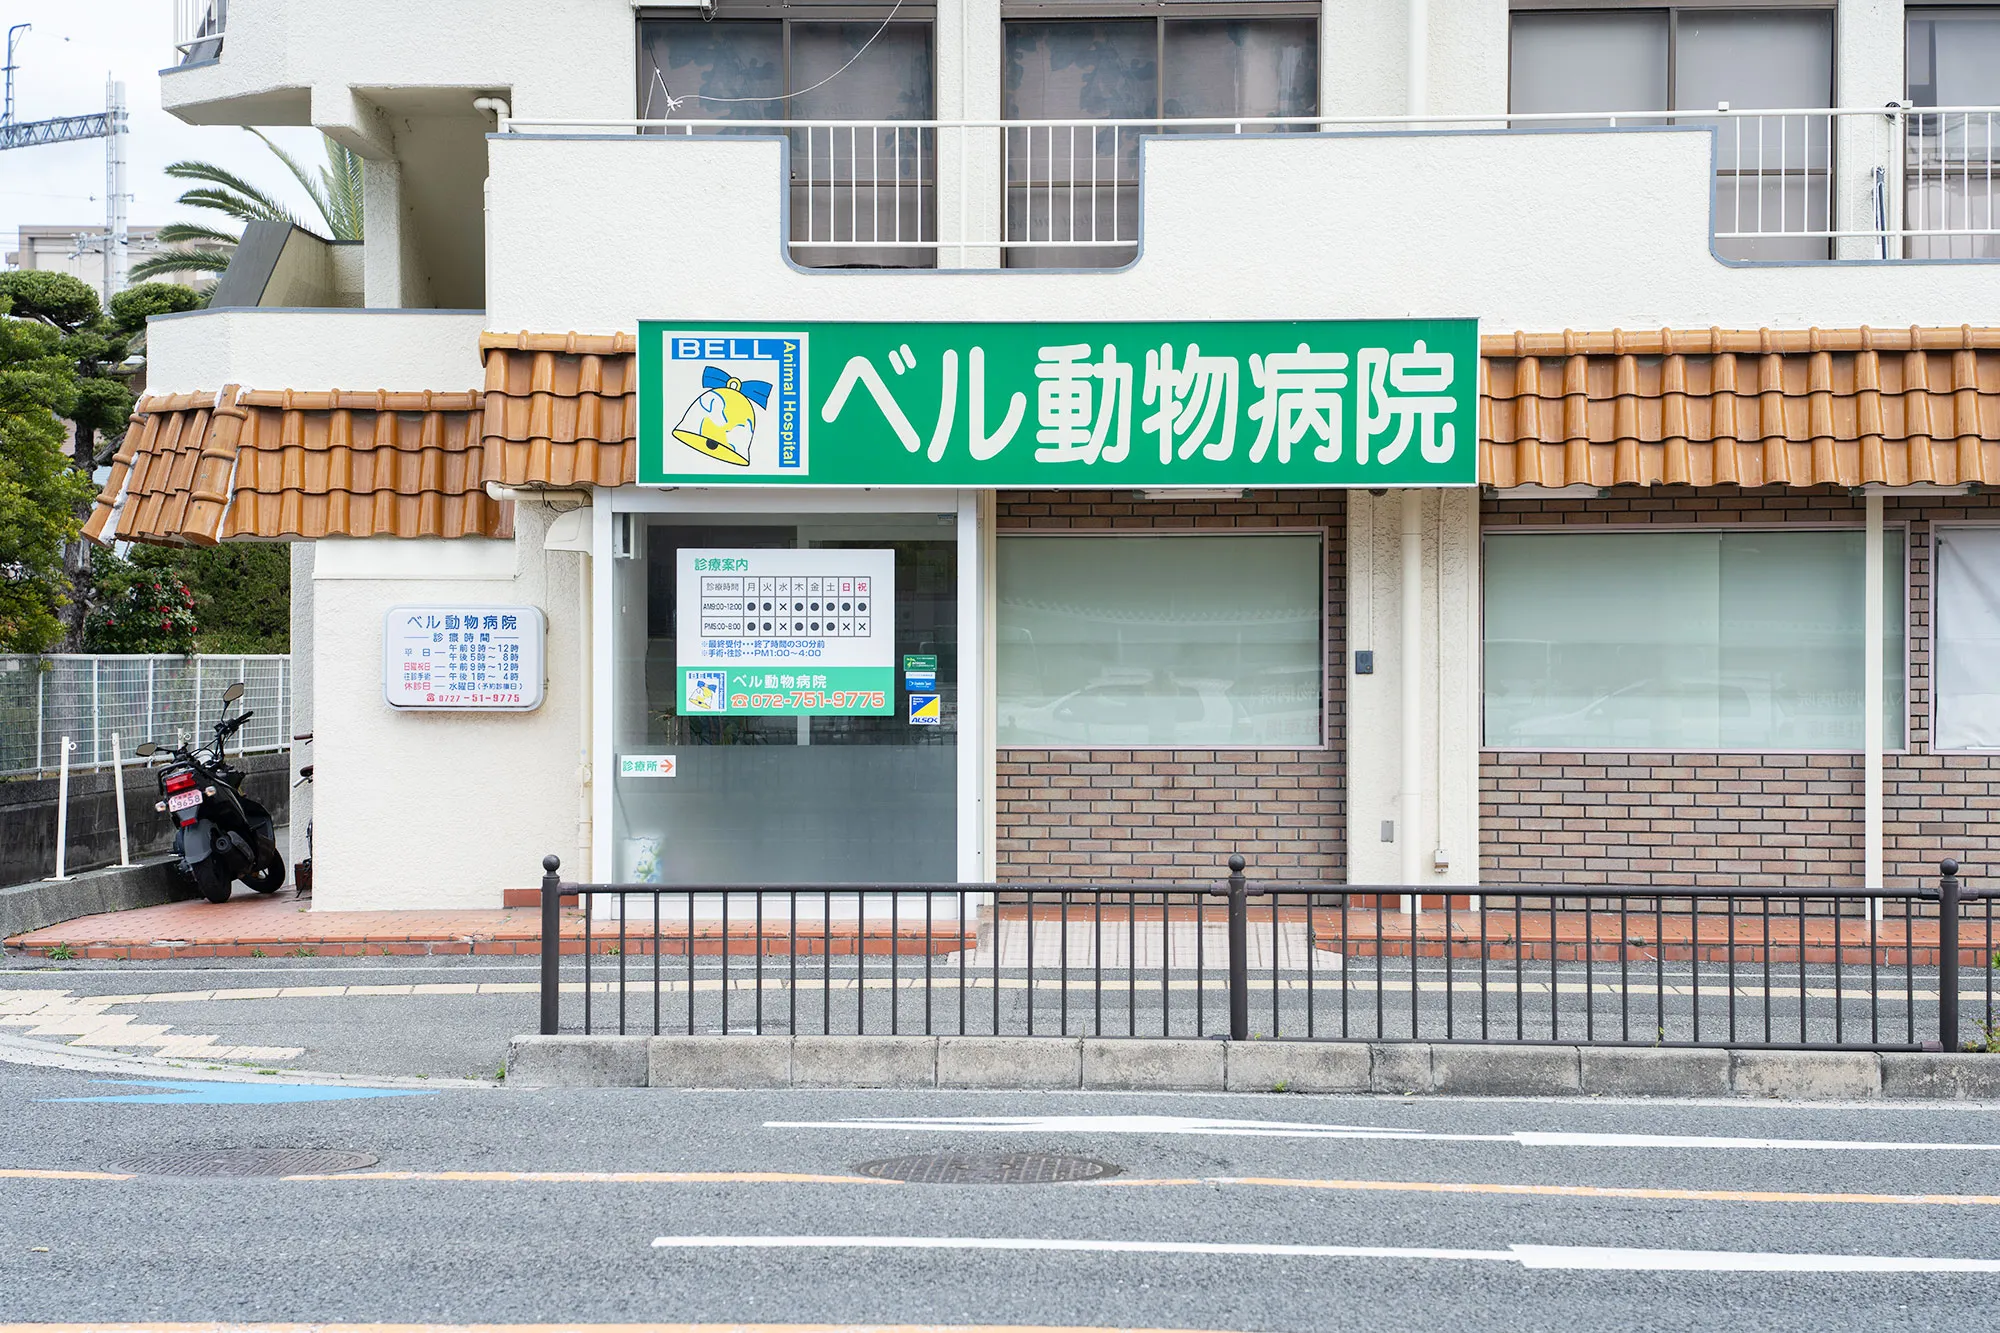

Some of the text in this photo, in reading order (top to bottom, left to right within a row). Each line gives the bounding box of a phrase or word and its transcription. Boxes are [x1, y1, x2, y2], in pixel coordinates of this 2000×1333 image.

[678, 339, 772, 359] BELL
[780, 341, 796, 464] Animal Hospital
[821, 340, 1456, 466] ベル動物病院
[694, 557, 748, 572] 診療案内
[706, 582, 867, 592] 診療時間 月 火 水 木 金 土 日 祝
[407, 615, 517, 630] ベル動物病院
[404, 662, 431, 671] 日曜祝日
[404, 672, 431, 681] 往診手術
[732, 674, 827, 689] ベル動物病院
[404, 681, 431, 691] 休診日
[751, 691, 885, 708] 072-751-9775
[622, 760, 657, 772] 診療所
[176, 794, 201, 809] 9658
